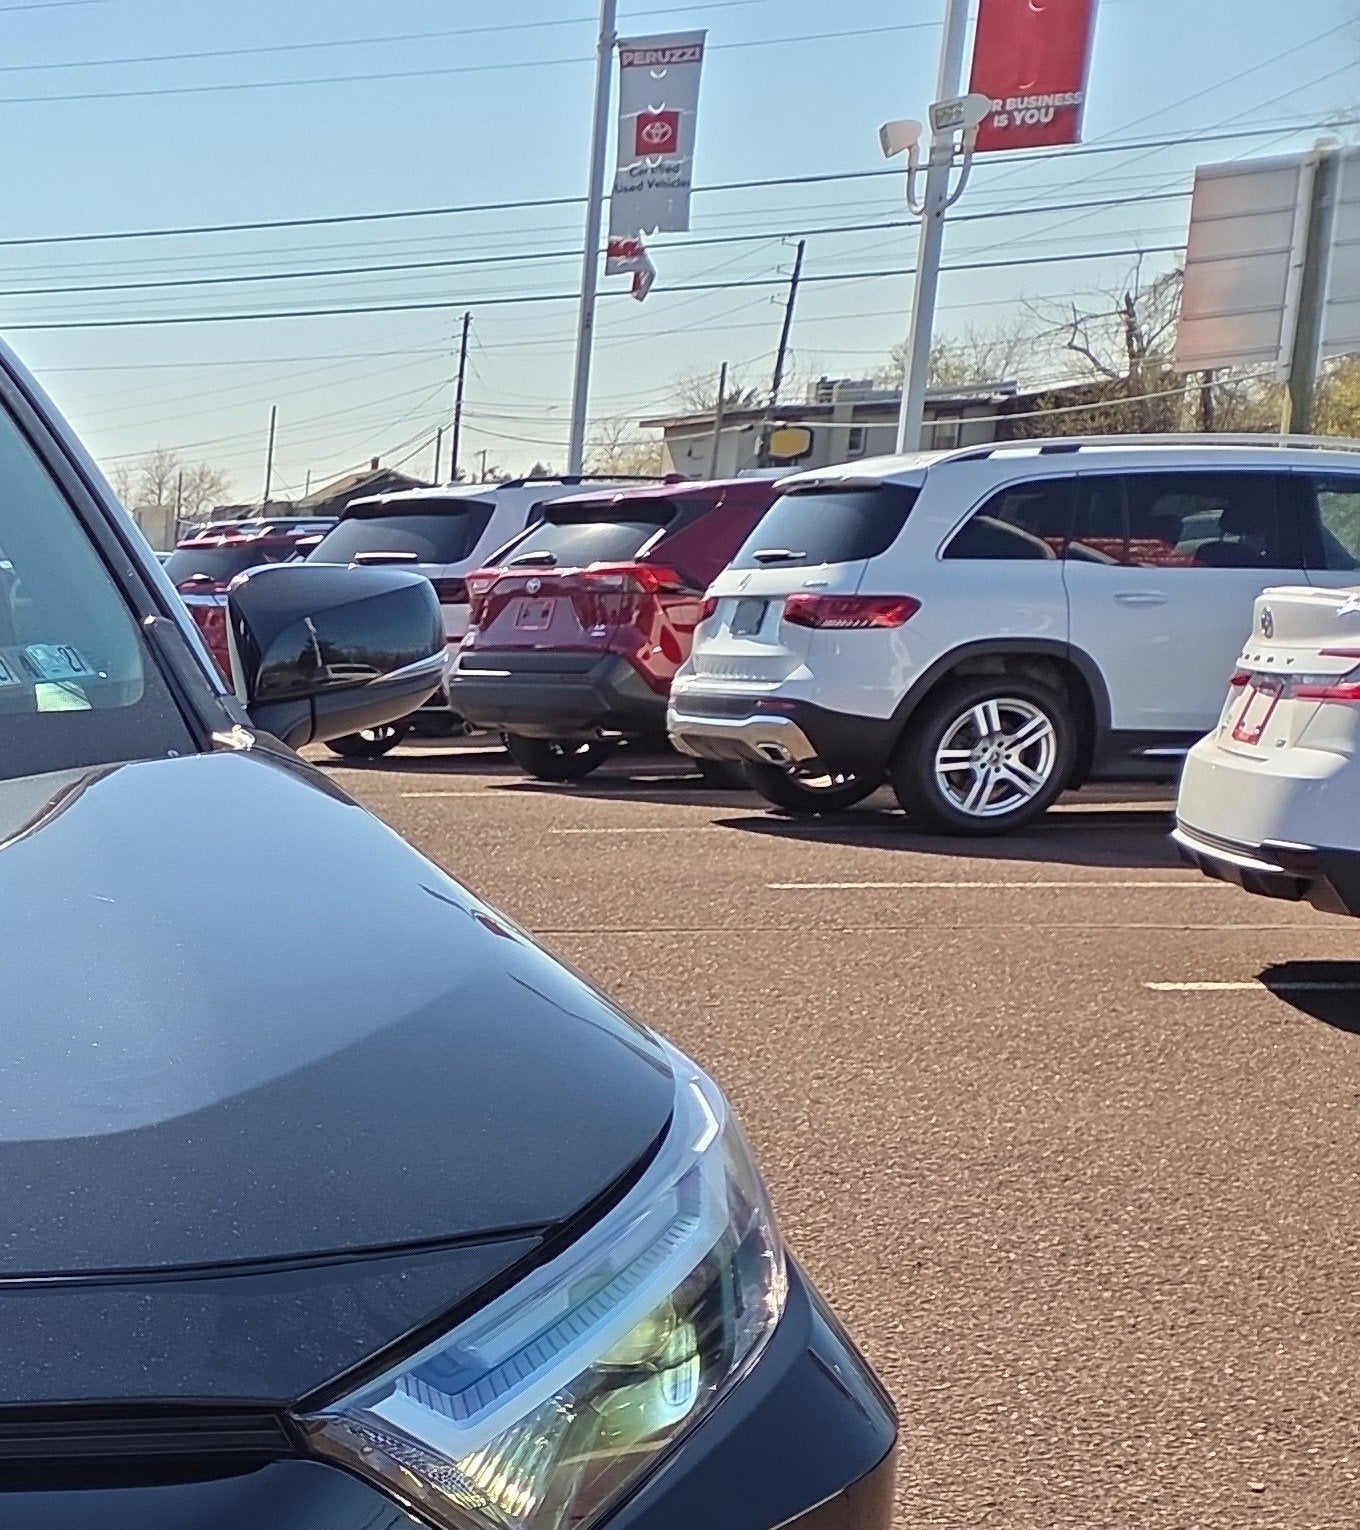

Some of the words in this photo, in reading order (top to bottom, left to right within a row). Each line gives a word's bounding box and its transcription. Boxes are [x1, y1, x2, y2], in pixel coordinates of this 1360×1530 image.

[621, 47, 700, 66] PERUZZI
[1006, 91, 1083, 111] BUSINESS
[1013, 107, 1054, 125] YOU
